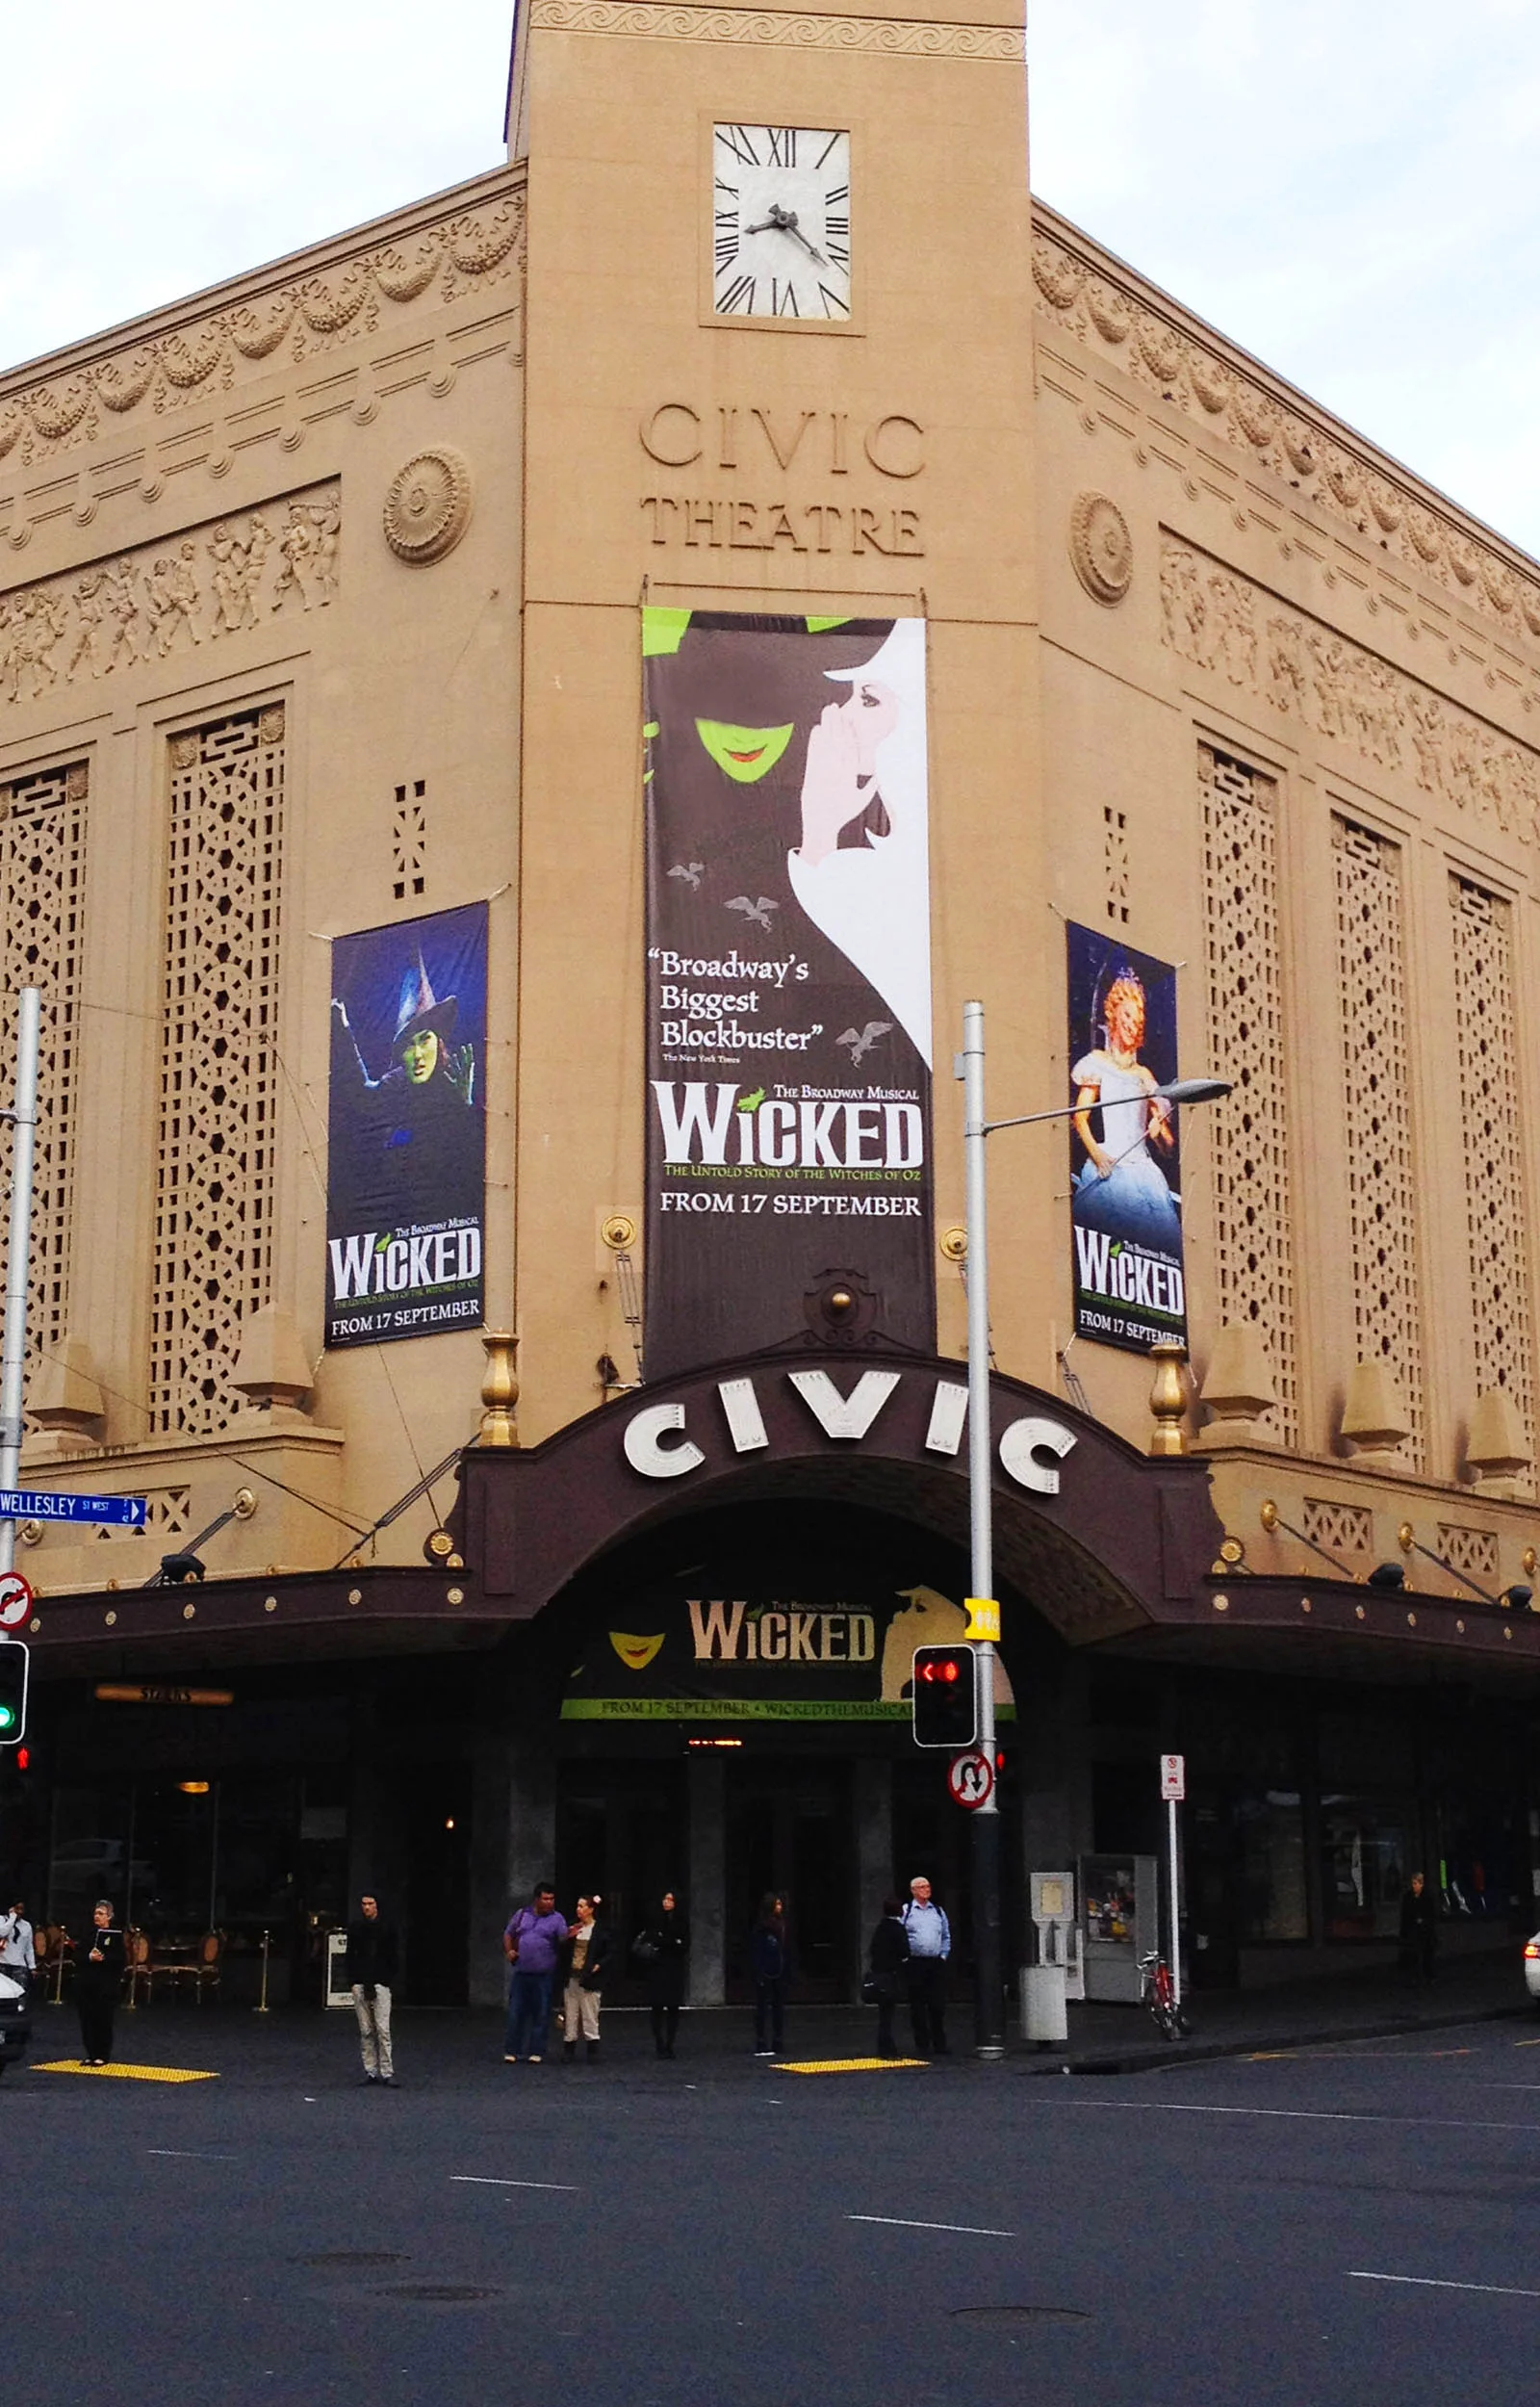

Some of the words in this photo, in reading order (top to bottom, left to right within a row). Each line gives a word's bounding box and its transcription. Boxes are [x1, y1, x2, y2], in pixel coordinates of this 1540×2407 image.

[767, 128, 796, 168] XII
[825, 185, 849, 205] II
[825, 217, 849, 234] III
[639, 403, 926, 479] CIVIC
[640, 497, 924, 556] THEATRE
[660, 986, 759, 1020] Biggest
[662, 1053, 678, 1062] The
[680, 1054, 697, 1063] New
[698, 1054, 716, 1064] York
[718, 1055, 740, 1064] Times
[774, 1084, 801, 1099] THE
[802, 1085, 863, 1100] BROADWAY
[867, 1087, 919, 1100] MUSICAL
[664, 1165, 689, 1177] THE
[691, 1165, 741, 1178] UNTOLD
[744, 1166, 782, 1179] STORY
[785, 1169, 801, 1179] OF
[803, 1169, 825, 1179] THE
[829, 1169, 882, 1181] WITCHES
[885, 1170, 900, 1180] OF
[902, 1170, 921, 1181] OZ
[660, 1192, 734, 1213] FROM
[741, 1194, 767, 1213] 17
[773, 1195, 922, 1216] SEPTEMBER
[331, 1315, 373, 1336] FROM
[376, 1313, 392, 1328] 17
[395, 1299, 480, 1327] SEPTEMBER
[1080, 1309, 1111, 1331] FROM
[1114, 1319, 1124, 1333] 17
[1126, 1322, 1185, 1347] SEPTEMBER
[624, 1370, 1079, 1494] CIVIC
[0, 1493, 76, 1515] WELLESLEY
[602, 1700, 646, 1715] FROM
[648, 1700, 663, 1715] 17
[666, 1700, 751, 1716] SEPTEMBER
